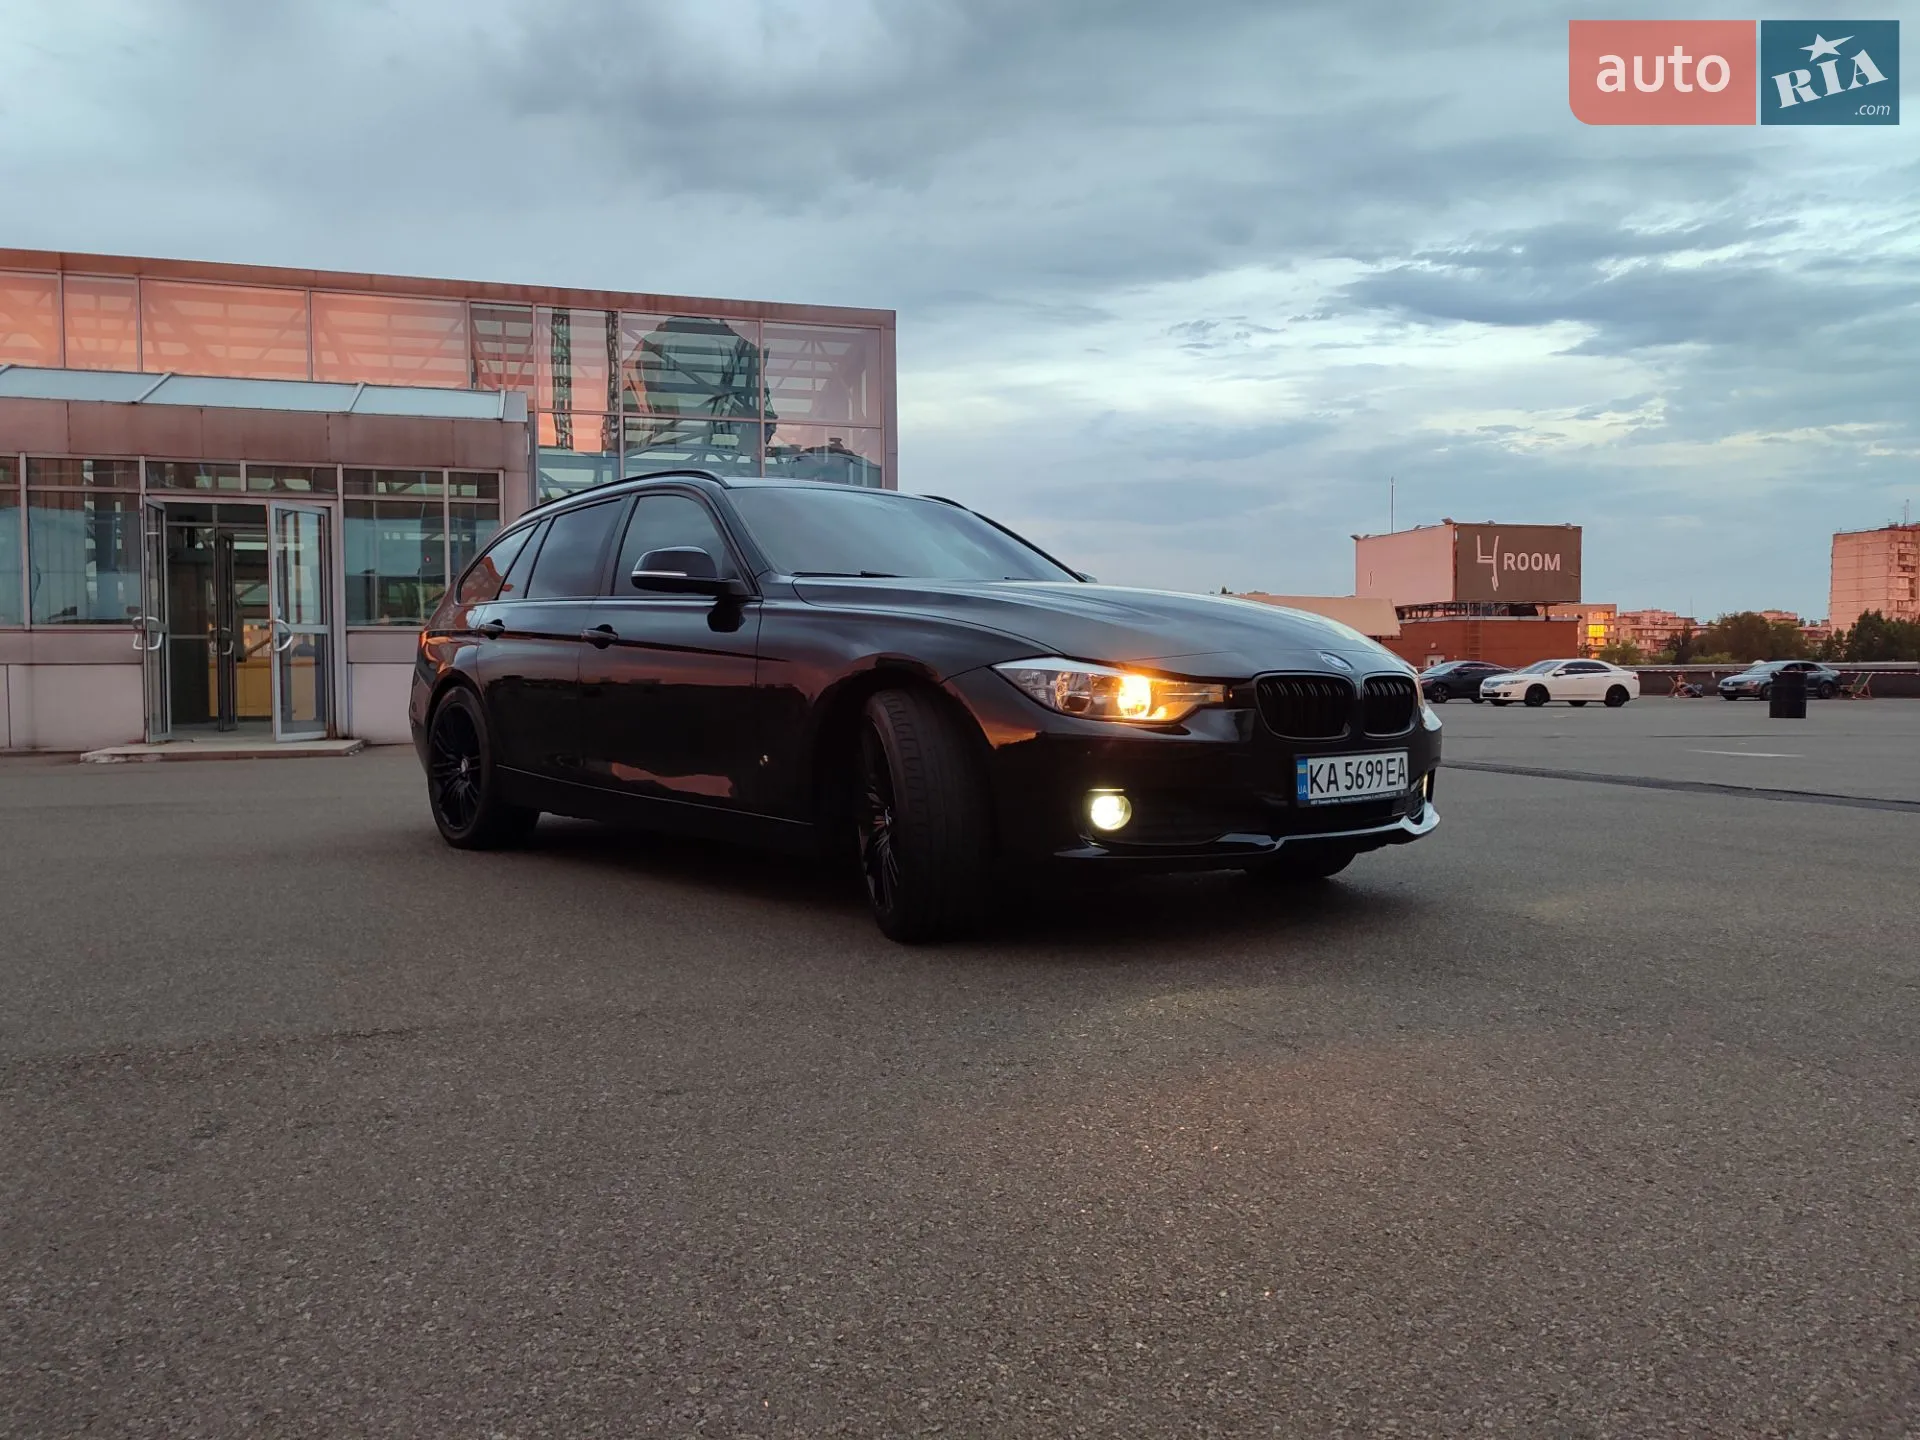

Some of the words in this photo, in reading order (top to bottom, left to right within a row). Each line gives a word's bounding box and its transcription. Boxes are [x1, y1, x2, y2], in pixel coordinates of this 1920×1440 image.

[1503, 552, 1561, 571] ROOM
[1309, 762, 1340, 795] KA
[1344, 759, 1384, 791] 5699
[1386, 757, 1406, 786] EA
